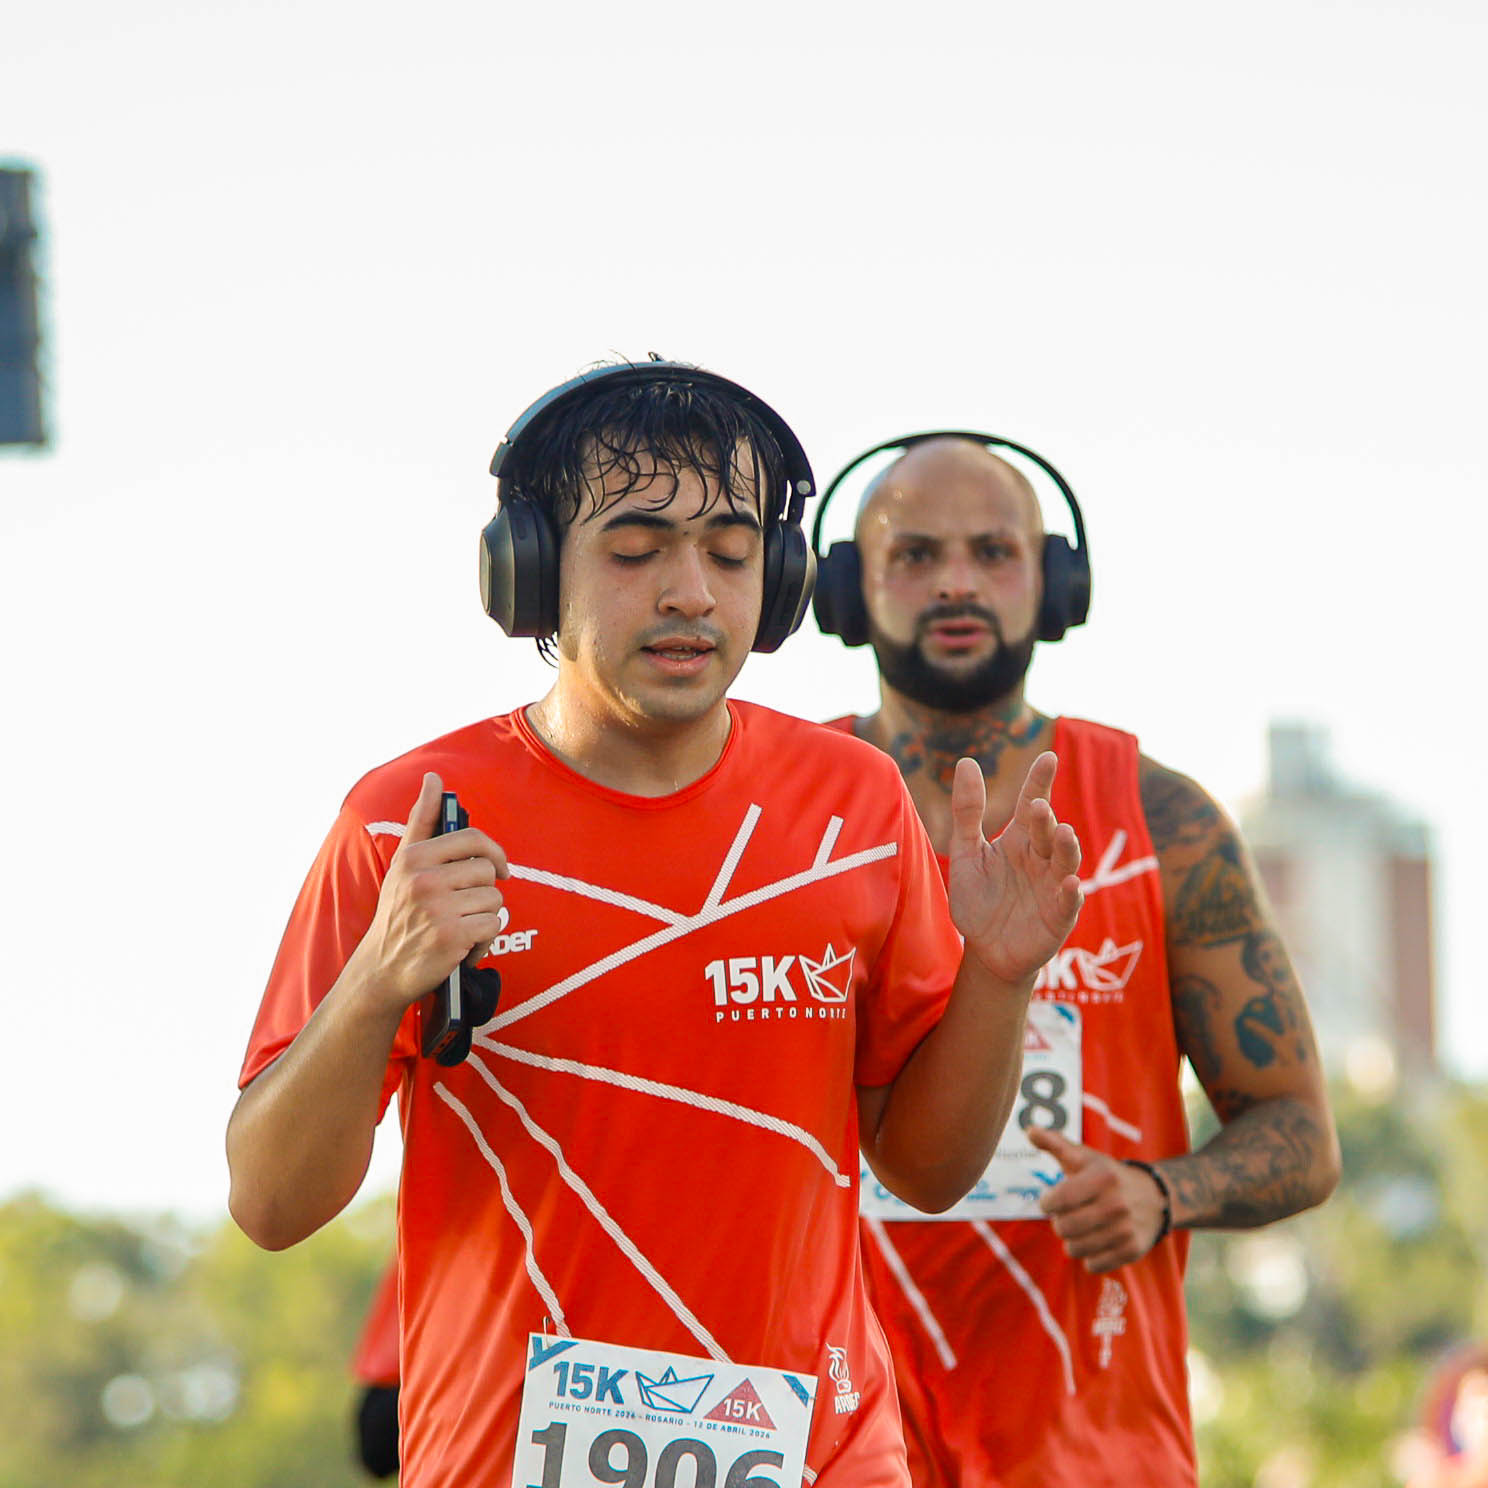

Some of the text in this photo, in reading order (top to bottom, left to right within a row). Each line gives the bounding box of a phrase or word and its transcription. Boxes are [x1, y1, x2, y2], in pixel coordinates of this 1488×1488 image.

[705, 955, 797, 1006] 15K
[716, 1007, 797, 1023] PUERTO
[553, 1361, 629, 1404] 15K
[549, 1401, 581, 1412] PUERTO
[584, 1405, 611, 1416] NORTE
[645, 1414, 683, 1425] ROSARIO
[706, 1422, 717, 1431] DE
[721, 1424, 746, 1435] ABRIL
[723, 1398, 762, 1421] 15K
